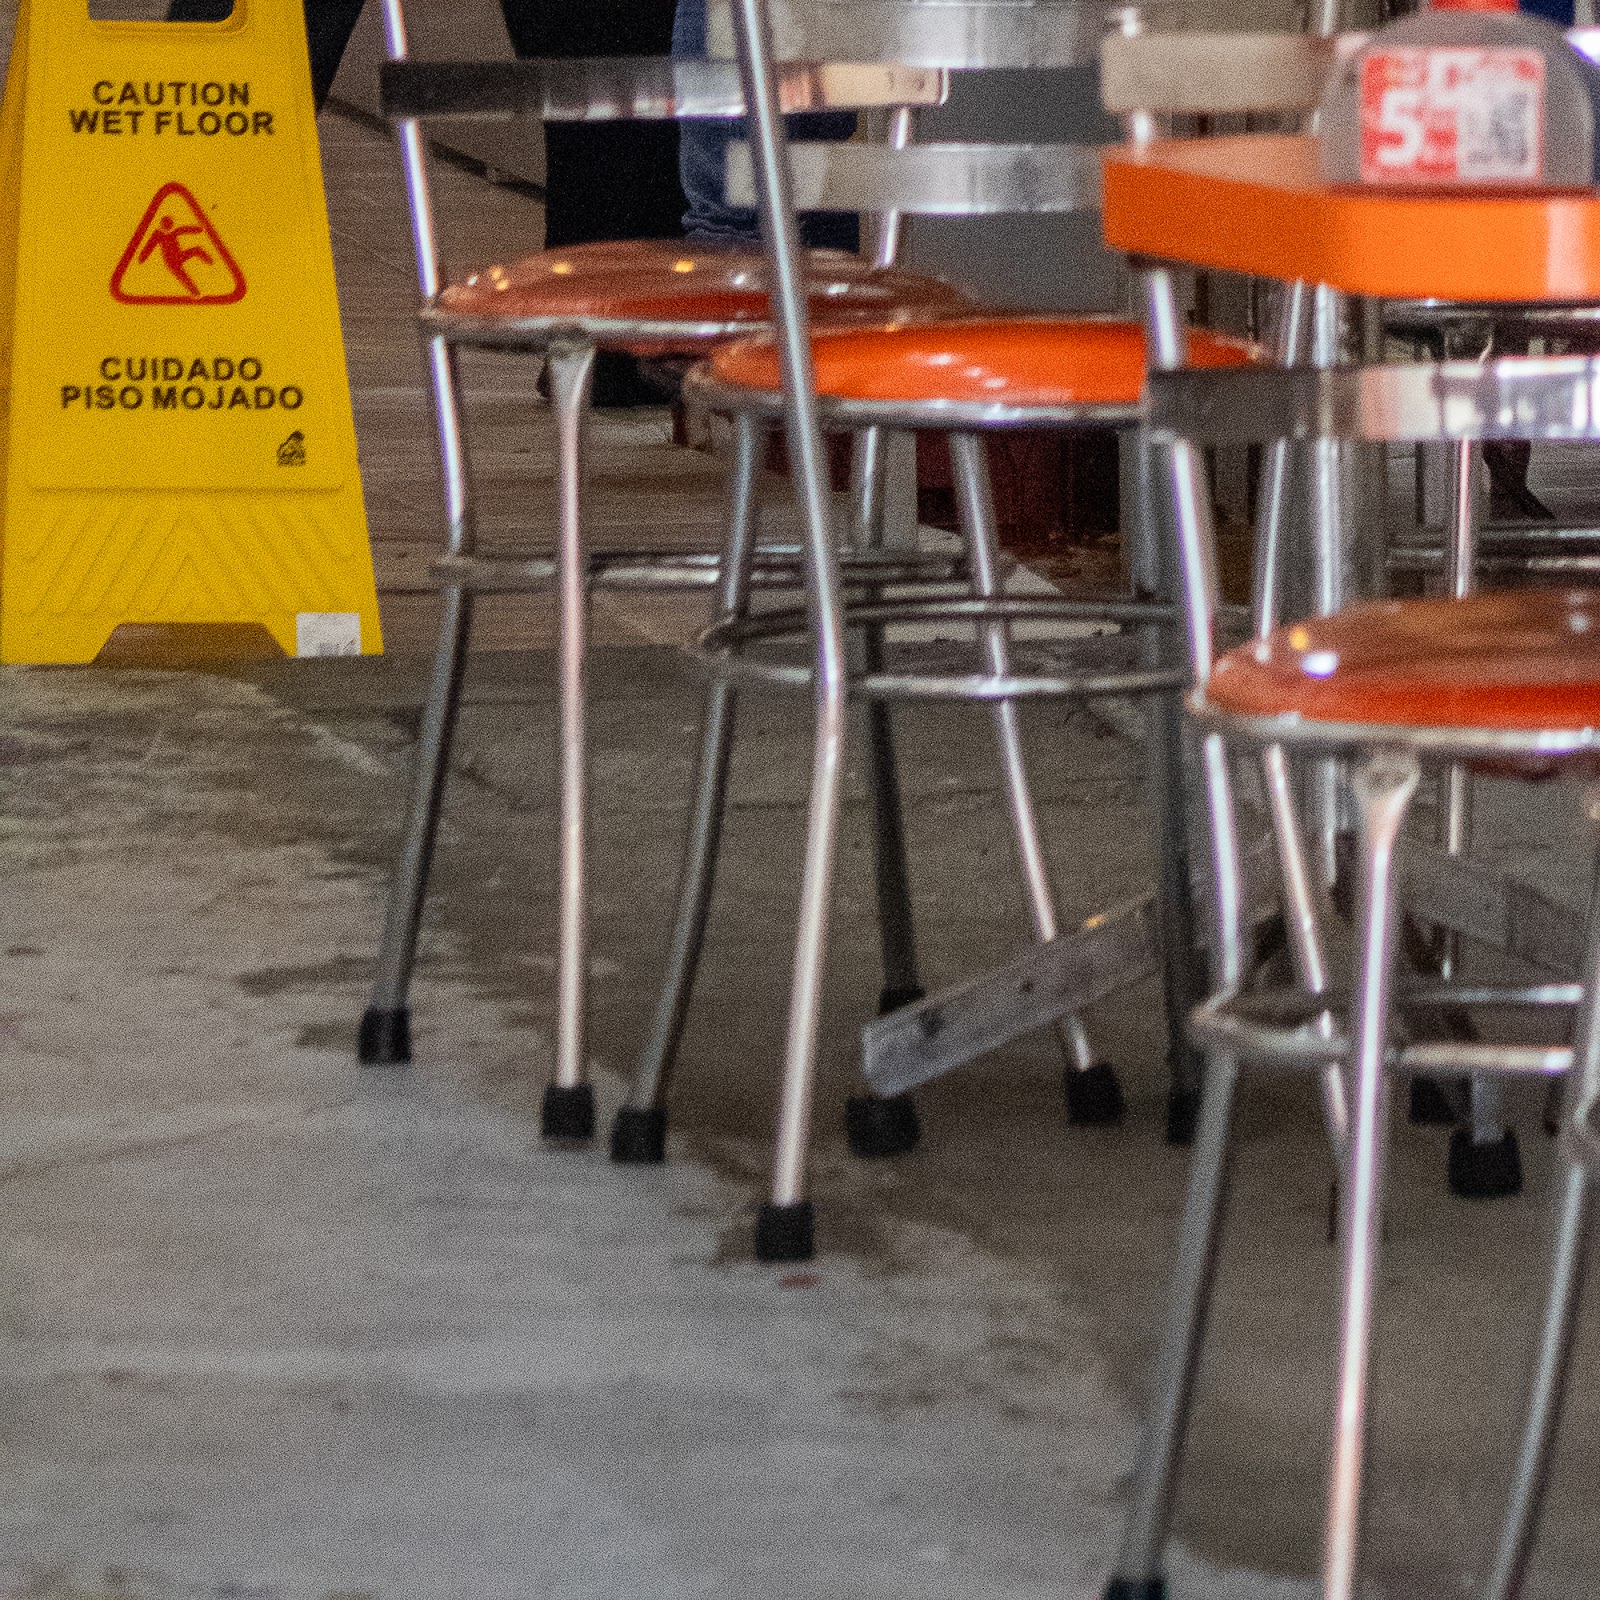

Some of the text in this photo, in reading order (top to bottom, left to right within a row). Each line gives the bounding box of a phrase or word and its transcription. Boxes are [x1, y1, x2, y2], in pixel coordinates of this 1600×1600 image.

[93, 80, 250, 106] CAUTION
[69, 110, 274, 136] WET FLOOR
[1378, 89, 1424, 166] 5
[100, 357, 262, 381] CUIDADO
[61, 385, 303, 410] PISO MOJADO
